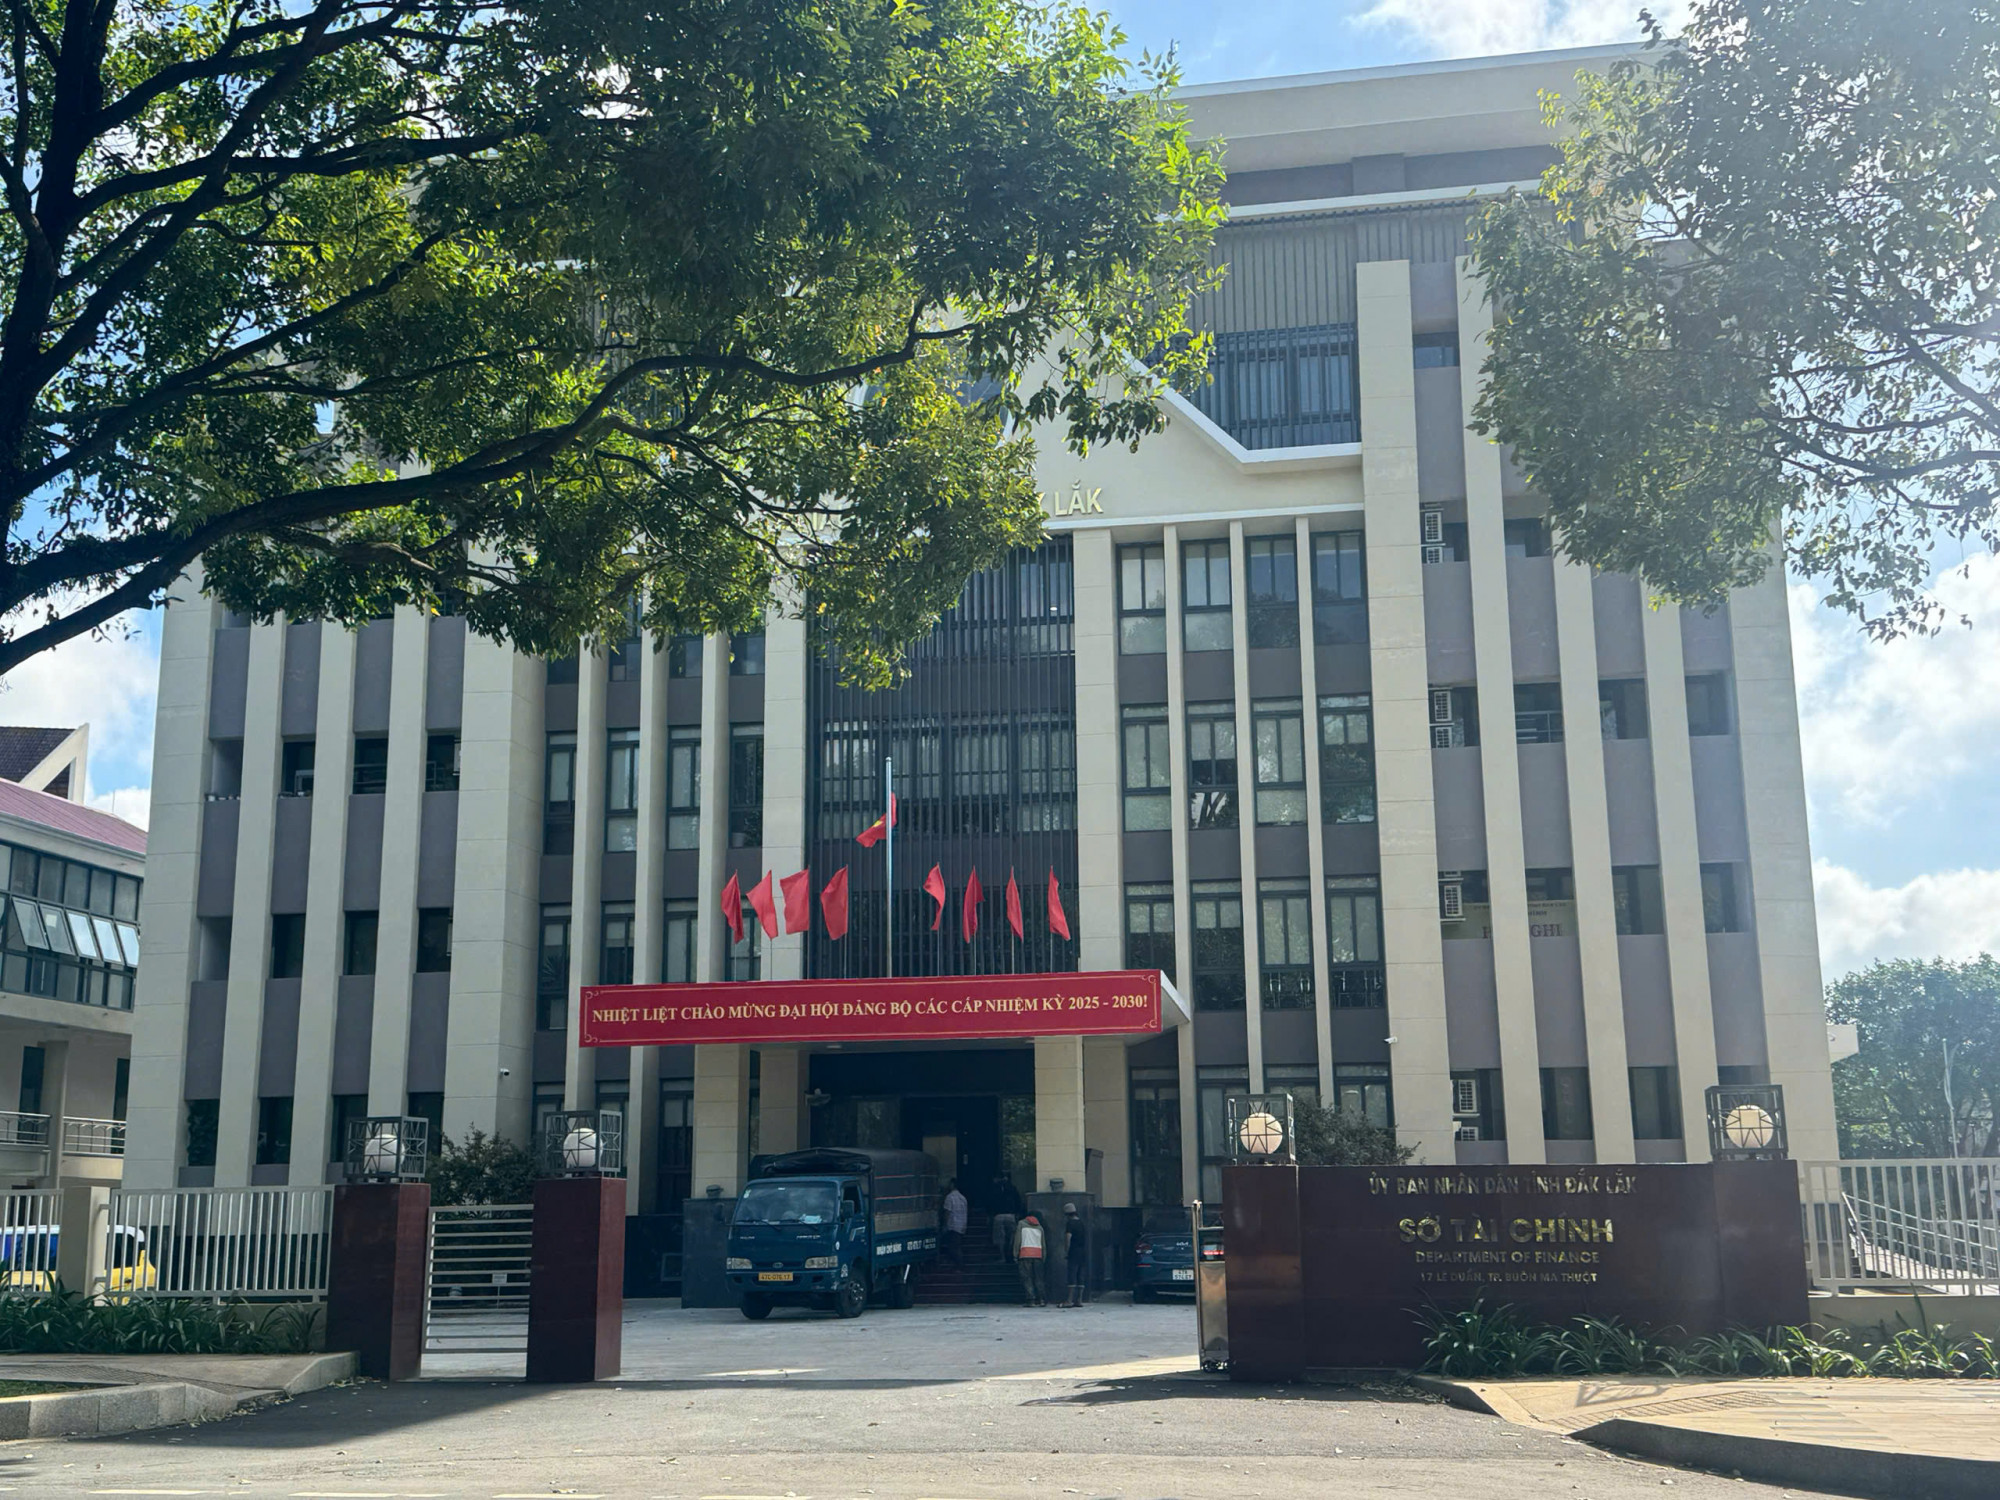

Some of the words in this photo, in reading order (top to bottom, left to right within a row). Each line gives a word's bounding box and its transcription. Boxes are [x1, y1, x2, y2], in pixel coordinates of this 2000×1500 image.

[1055, 479, 1104, 516] LẮK
[592, 1007, 640, 1025] NHIỆT
[642, 1006, 678, 1024] LIỆT
[681, 1003, 725, 1020] CHÀO
[728, 1002, 777, 1018] MỪNG
[779, 1003, 806, 1020] ĐẠI
[810, 1001, 839, 1019] HỘI
[842, 999, 886, 1016] ĐẢNG
[890, 1000, 912, 1018] BỘ
[915, 997, 948, 1014] CÁC
[951, 994, 983, 1012] CẤP
[985, 996, 1040, 1015] NHIỆM
[1042, 994, 1065, 1011] KỲ
[1068, 996, 1100, 1010] 2025
[1112, 994, 1148, 1009] 2030!
[1369, 1172, 1390, 1194] ỦY
[1397, 1176, 1429, 1195] BAN
[1434, 1172, 1480, 1195] NHÂN
[1484, 1173, 1518, 1195] DÂN
[1524, 1170, 1560, 1195] TỈNH
[1399, 1212, 1442, 1243] SỞ
[1450, 1212, 1499, 1243] TÀI
[1509, 1211, 1614, 1243] CHÍNH
[1416, 1252, 1507, 1264] DEPARTMENT
[1511, 1252, 1531, 1264] OF
[1534, 1252, 1600, 1264] FINANCE
